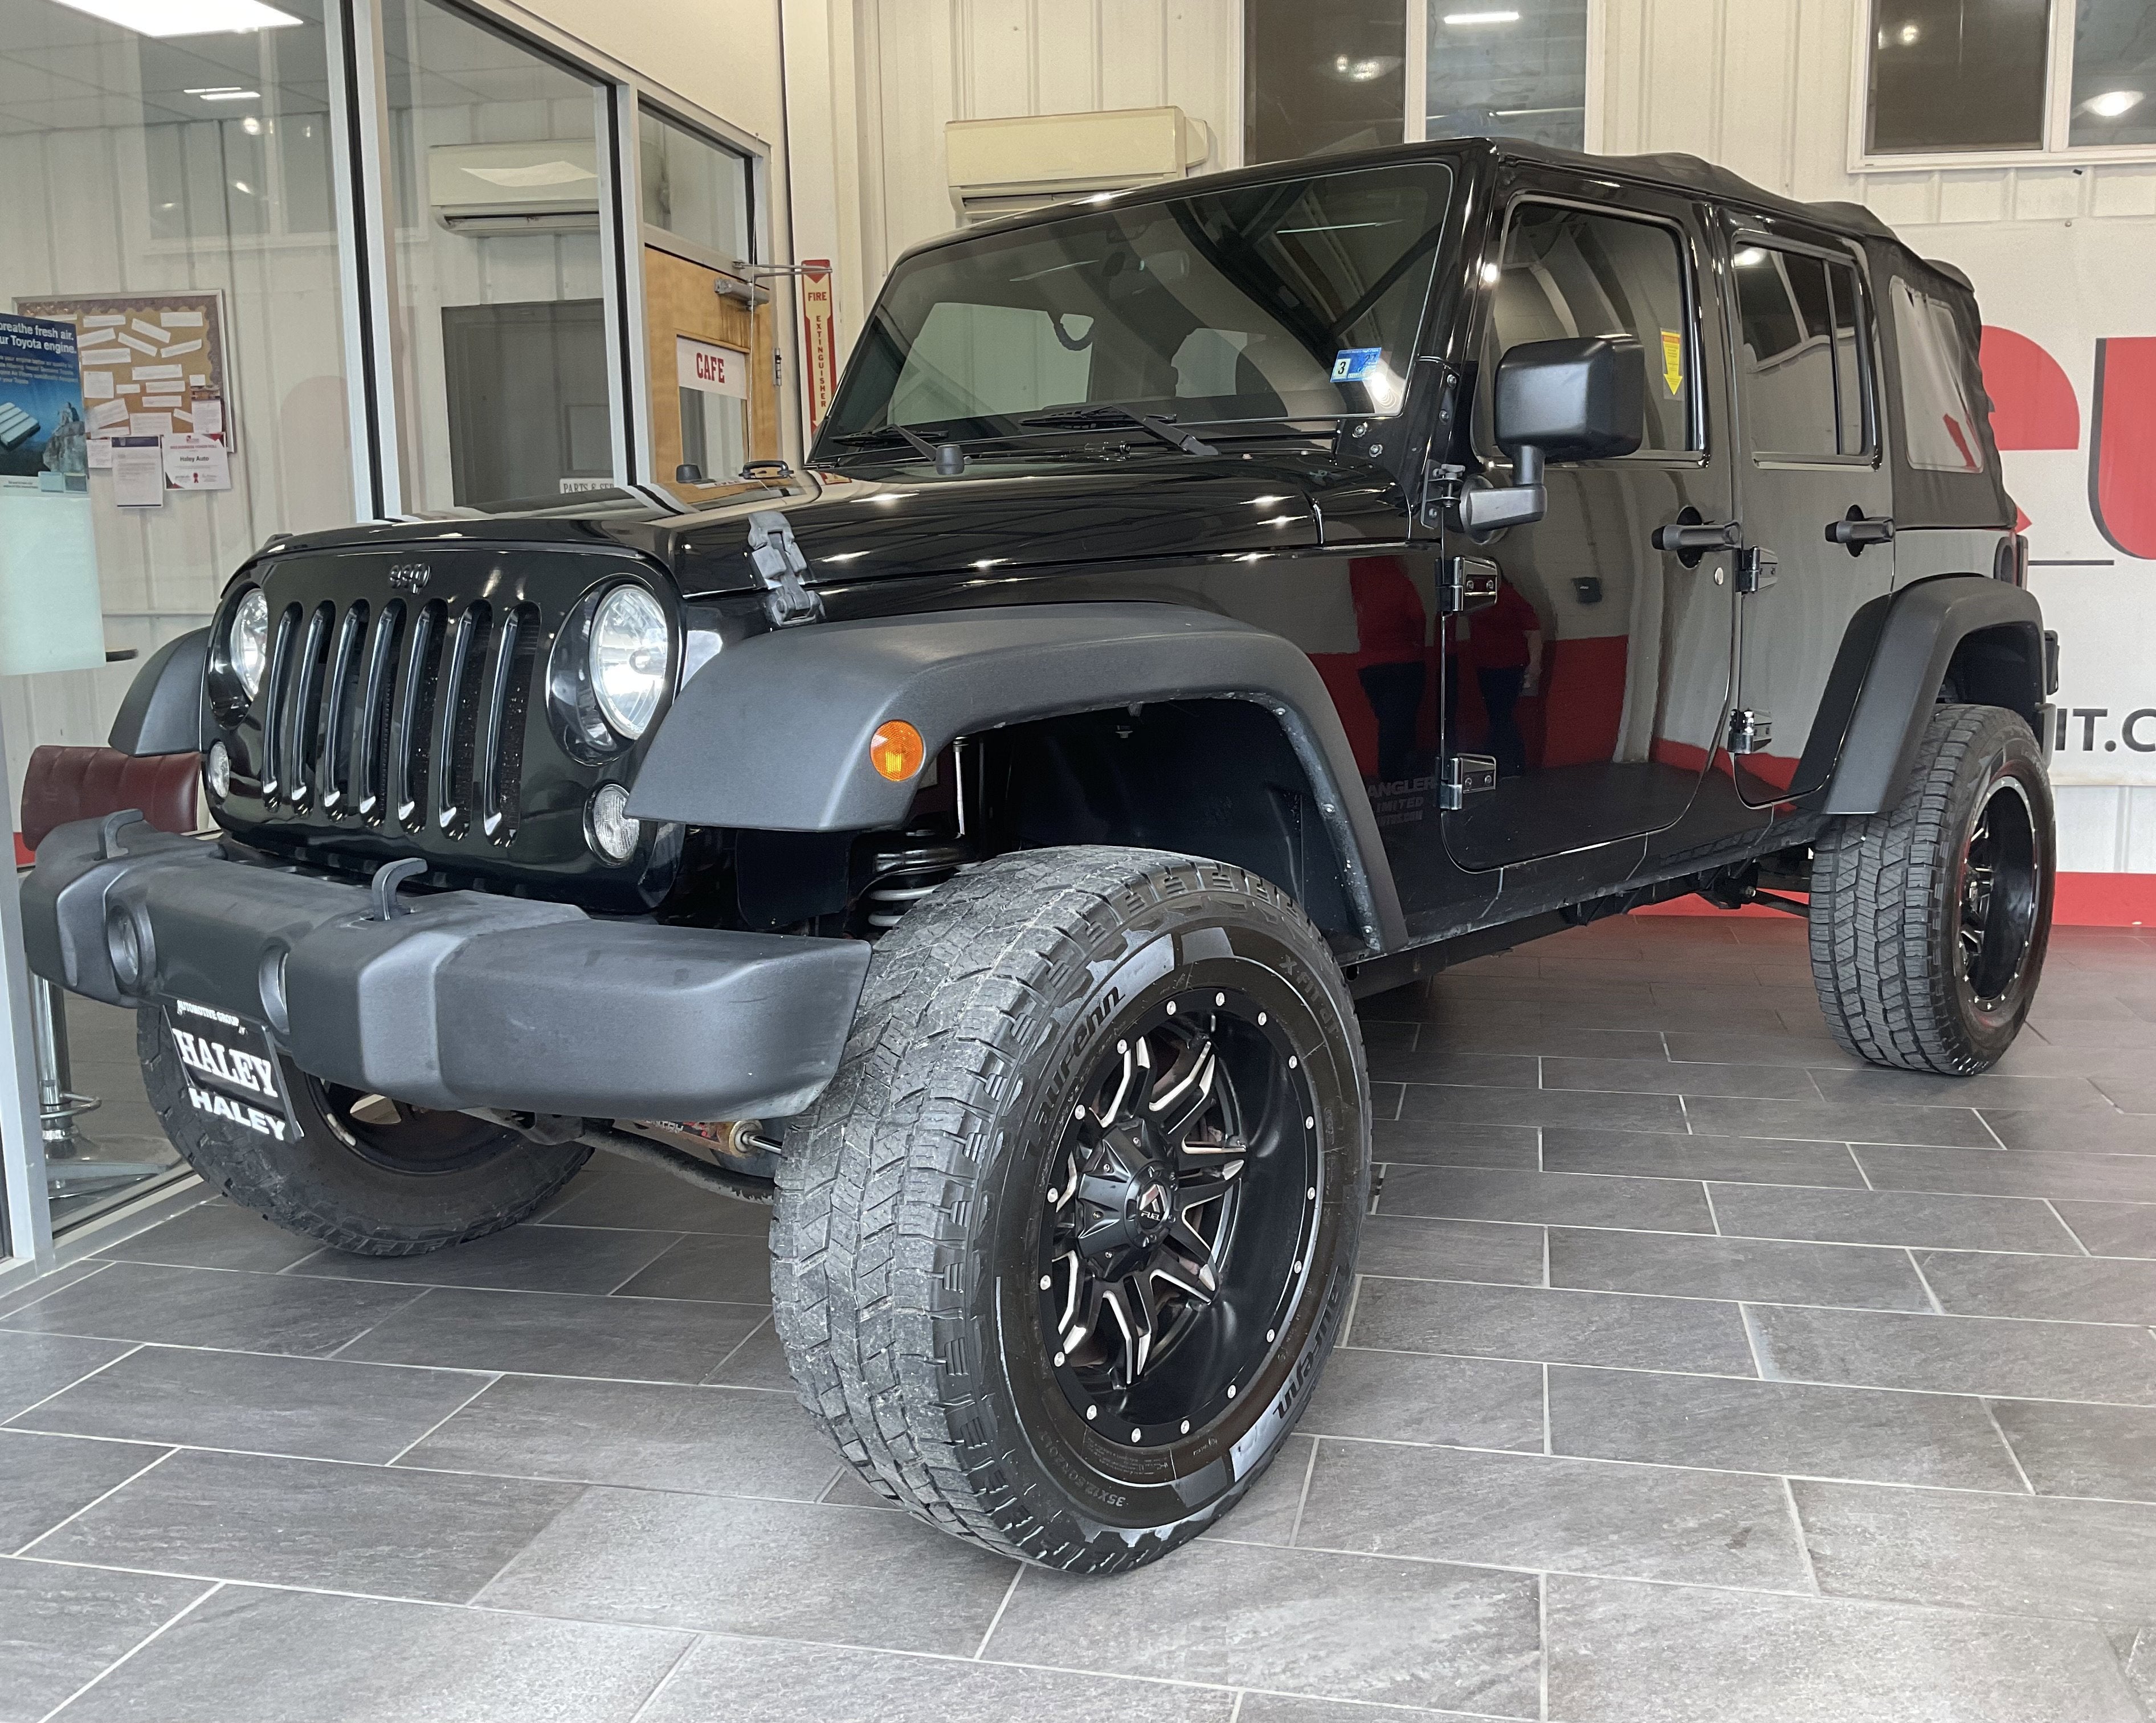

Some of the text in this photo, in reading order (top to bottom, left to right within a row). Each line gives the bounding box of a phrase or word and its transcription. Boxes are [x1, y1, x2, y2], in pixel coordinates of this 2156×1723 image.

[807, 292, 827, 301] FIRE
[35, 325, 58, 338] fresh
[60, 330, 74, 341] air.
[10, 335, 42, 349] Toyota
[44, 342, 77, 354] engine.
[696, 352, 725, 385] CAFE
[816, 316, 827, 408] EXTINGUISHER
[1338, 361, 1346, 374] 3
[564, 483, 589, 493] PARTS
[172, 1028, 278, 1098] HALEY
[188, 1087, 285, 1141] HALEY
[1141, 1210, 1161, 1222] FUEL
